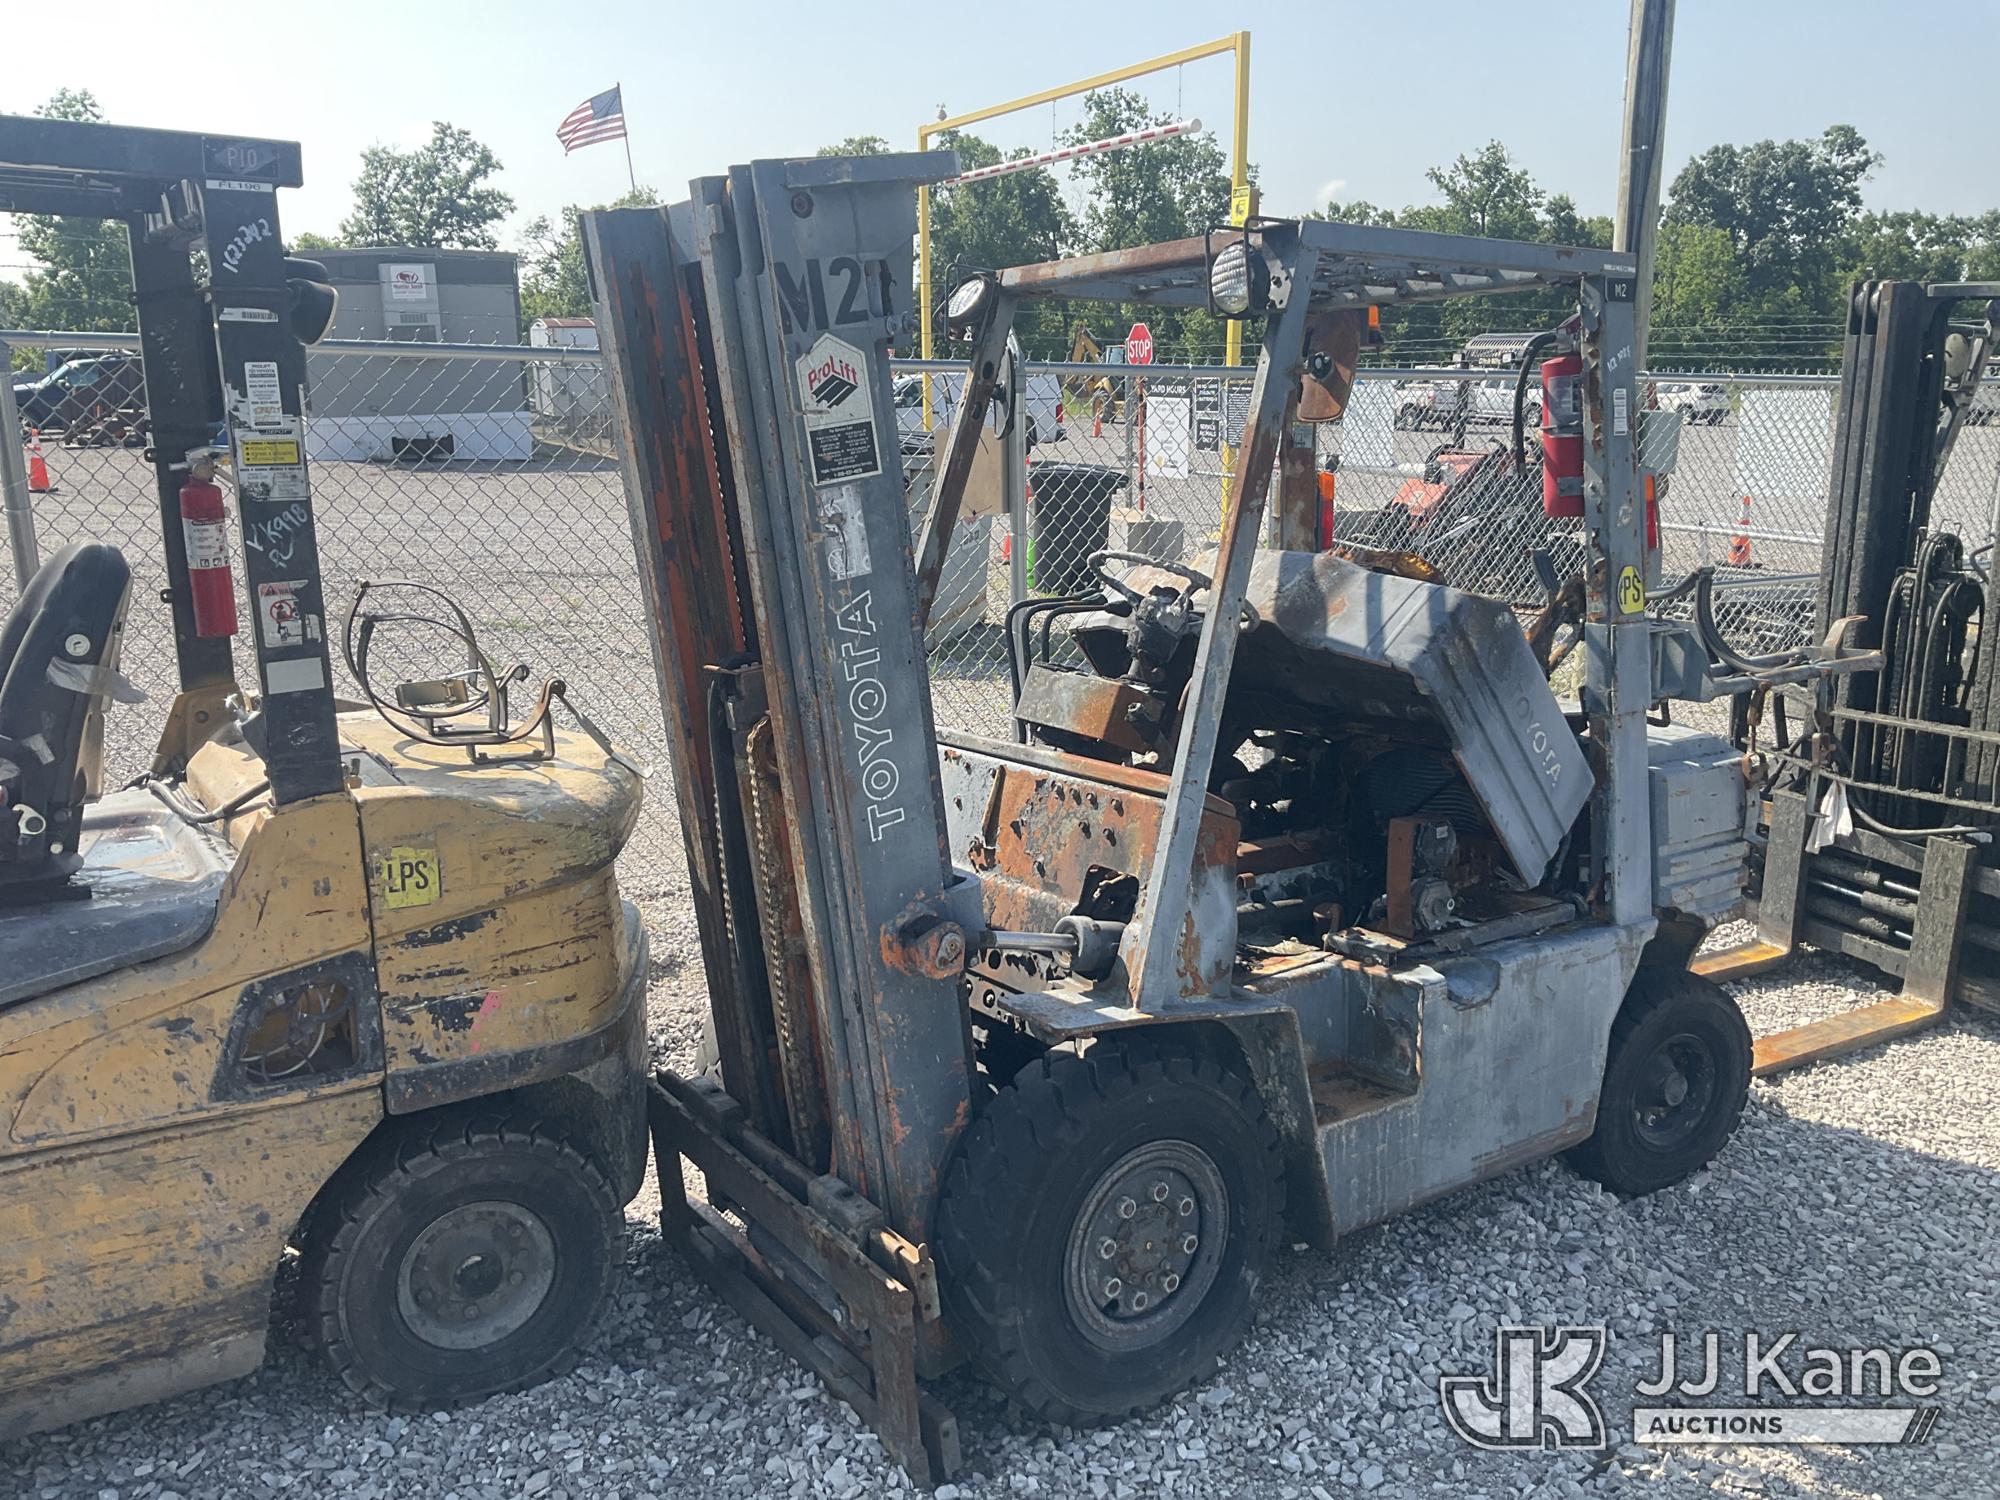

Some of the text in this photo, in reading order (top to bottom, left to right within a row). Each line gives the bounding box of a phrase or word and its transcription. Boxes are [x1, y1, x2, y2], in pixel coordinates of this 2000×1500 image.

[1615, 283, 1627, 297] M2
[1129, 339, 1151, 358] STOP
[836, 589, 905, 842] TOYOTA
[387, 860, 429, 893] LPS
